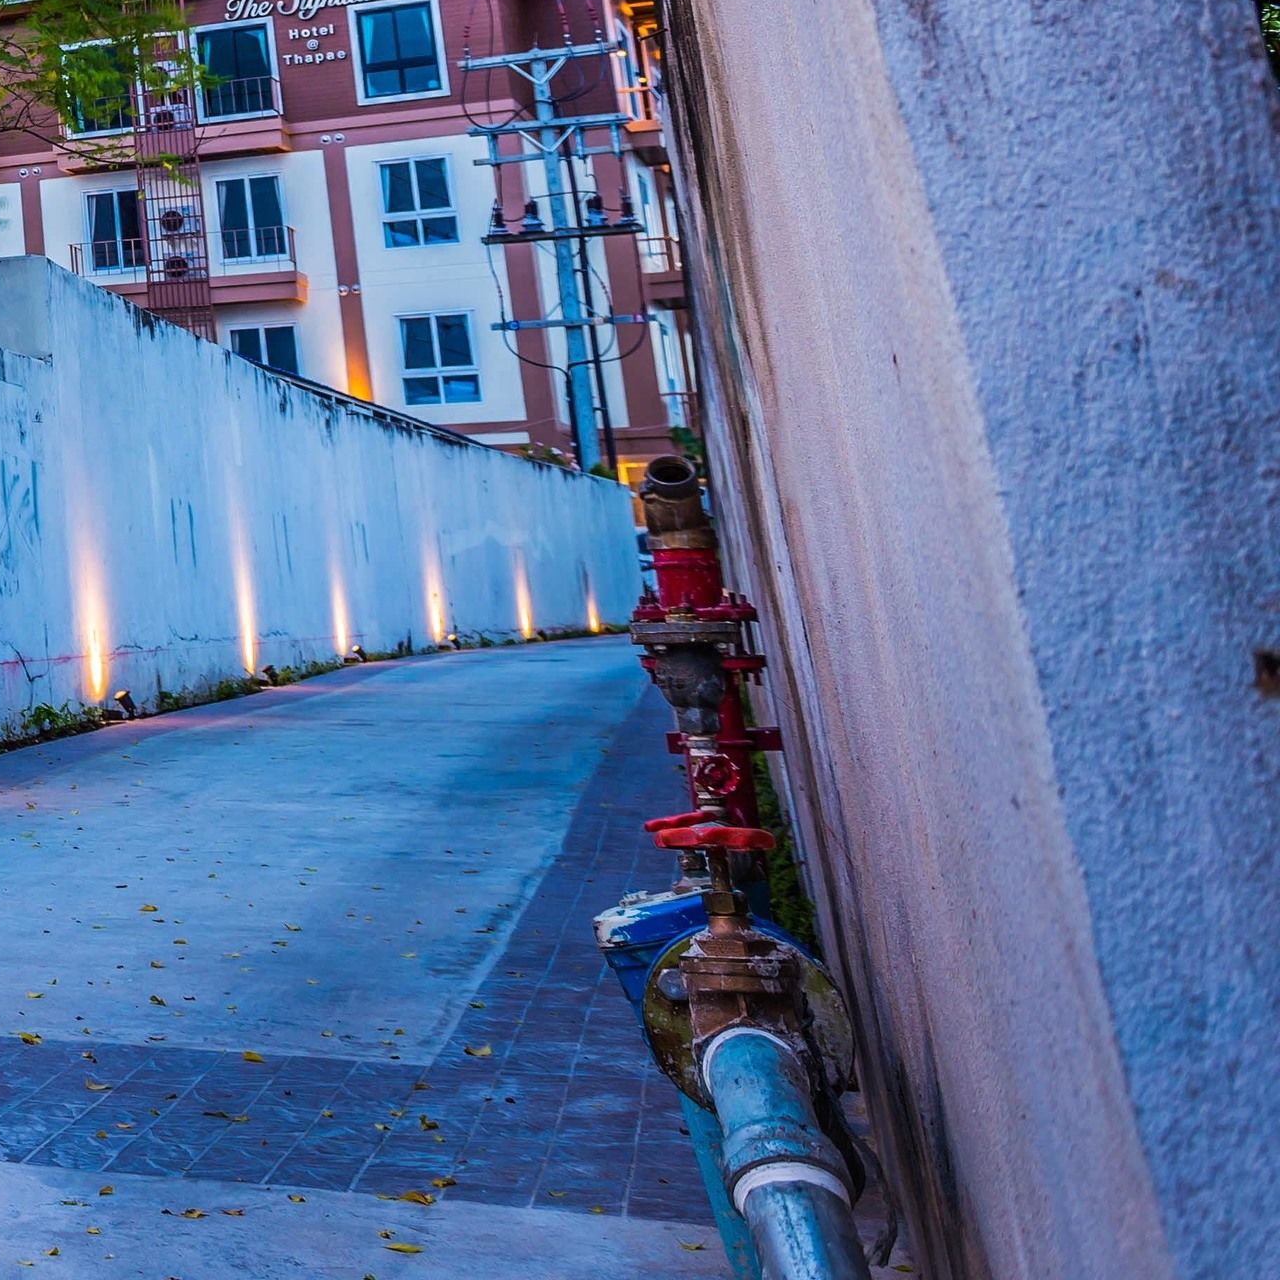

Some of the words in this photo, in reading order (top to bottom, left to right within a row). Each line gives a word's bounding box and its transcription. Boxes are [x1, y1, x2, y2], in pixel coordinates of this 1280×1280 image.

[288, 24, 335, 40] Hotel
[306, 39, 319, 50] @
[282, 50, 346, 66] Thapae
